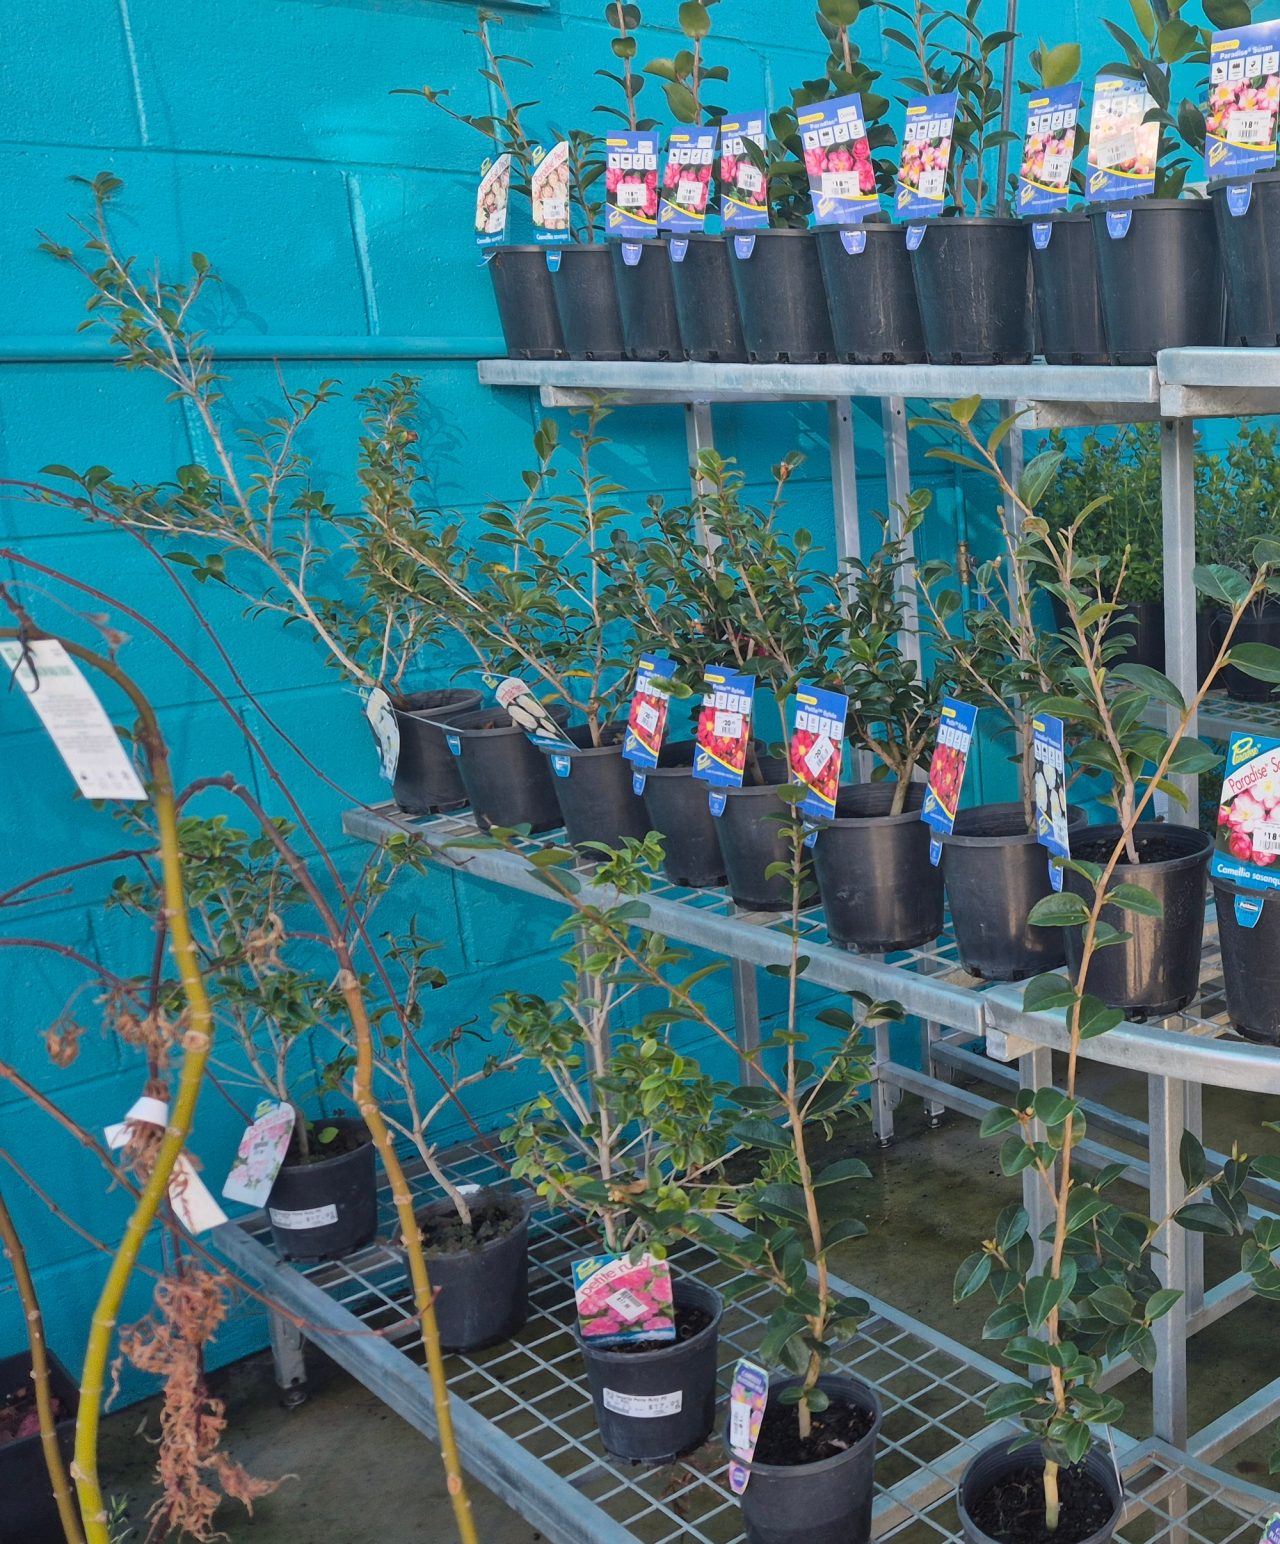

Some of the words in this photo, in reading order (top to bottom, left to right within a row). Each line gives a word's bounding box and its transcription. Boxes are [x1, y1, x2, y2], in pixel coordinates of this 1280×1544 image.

[1252, 45, 1273, 54] Susan
[1217, 863, 1251, 879] Camellia
[581, 1270, 617, 1298] petite
